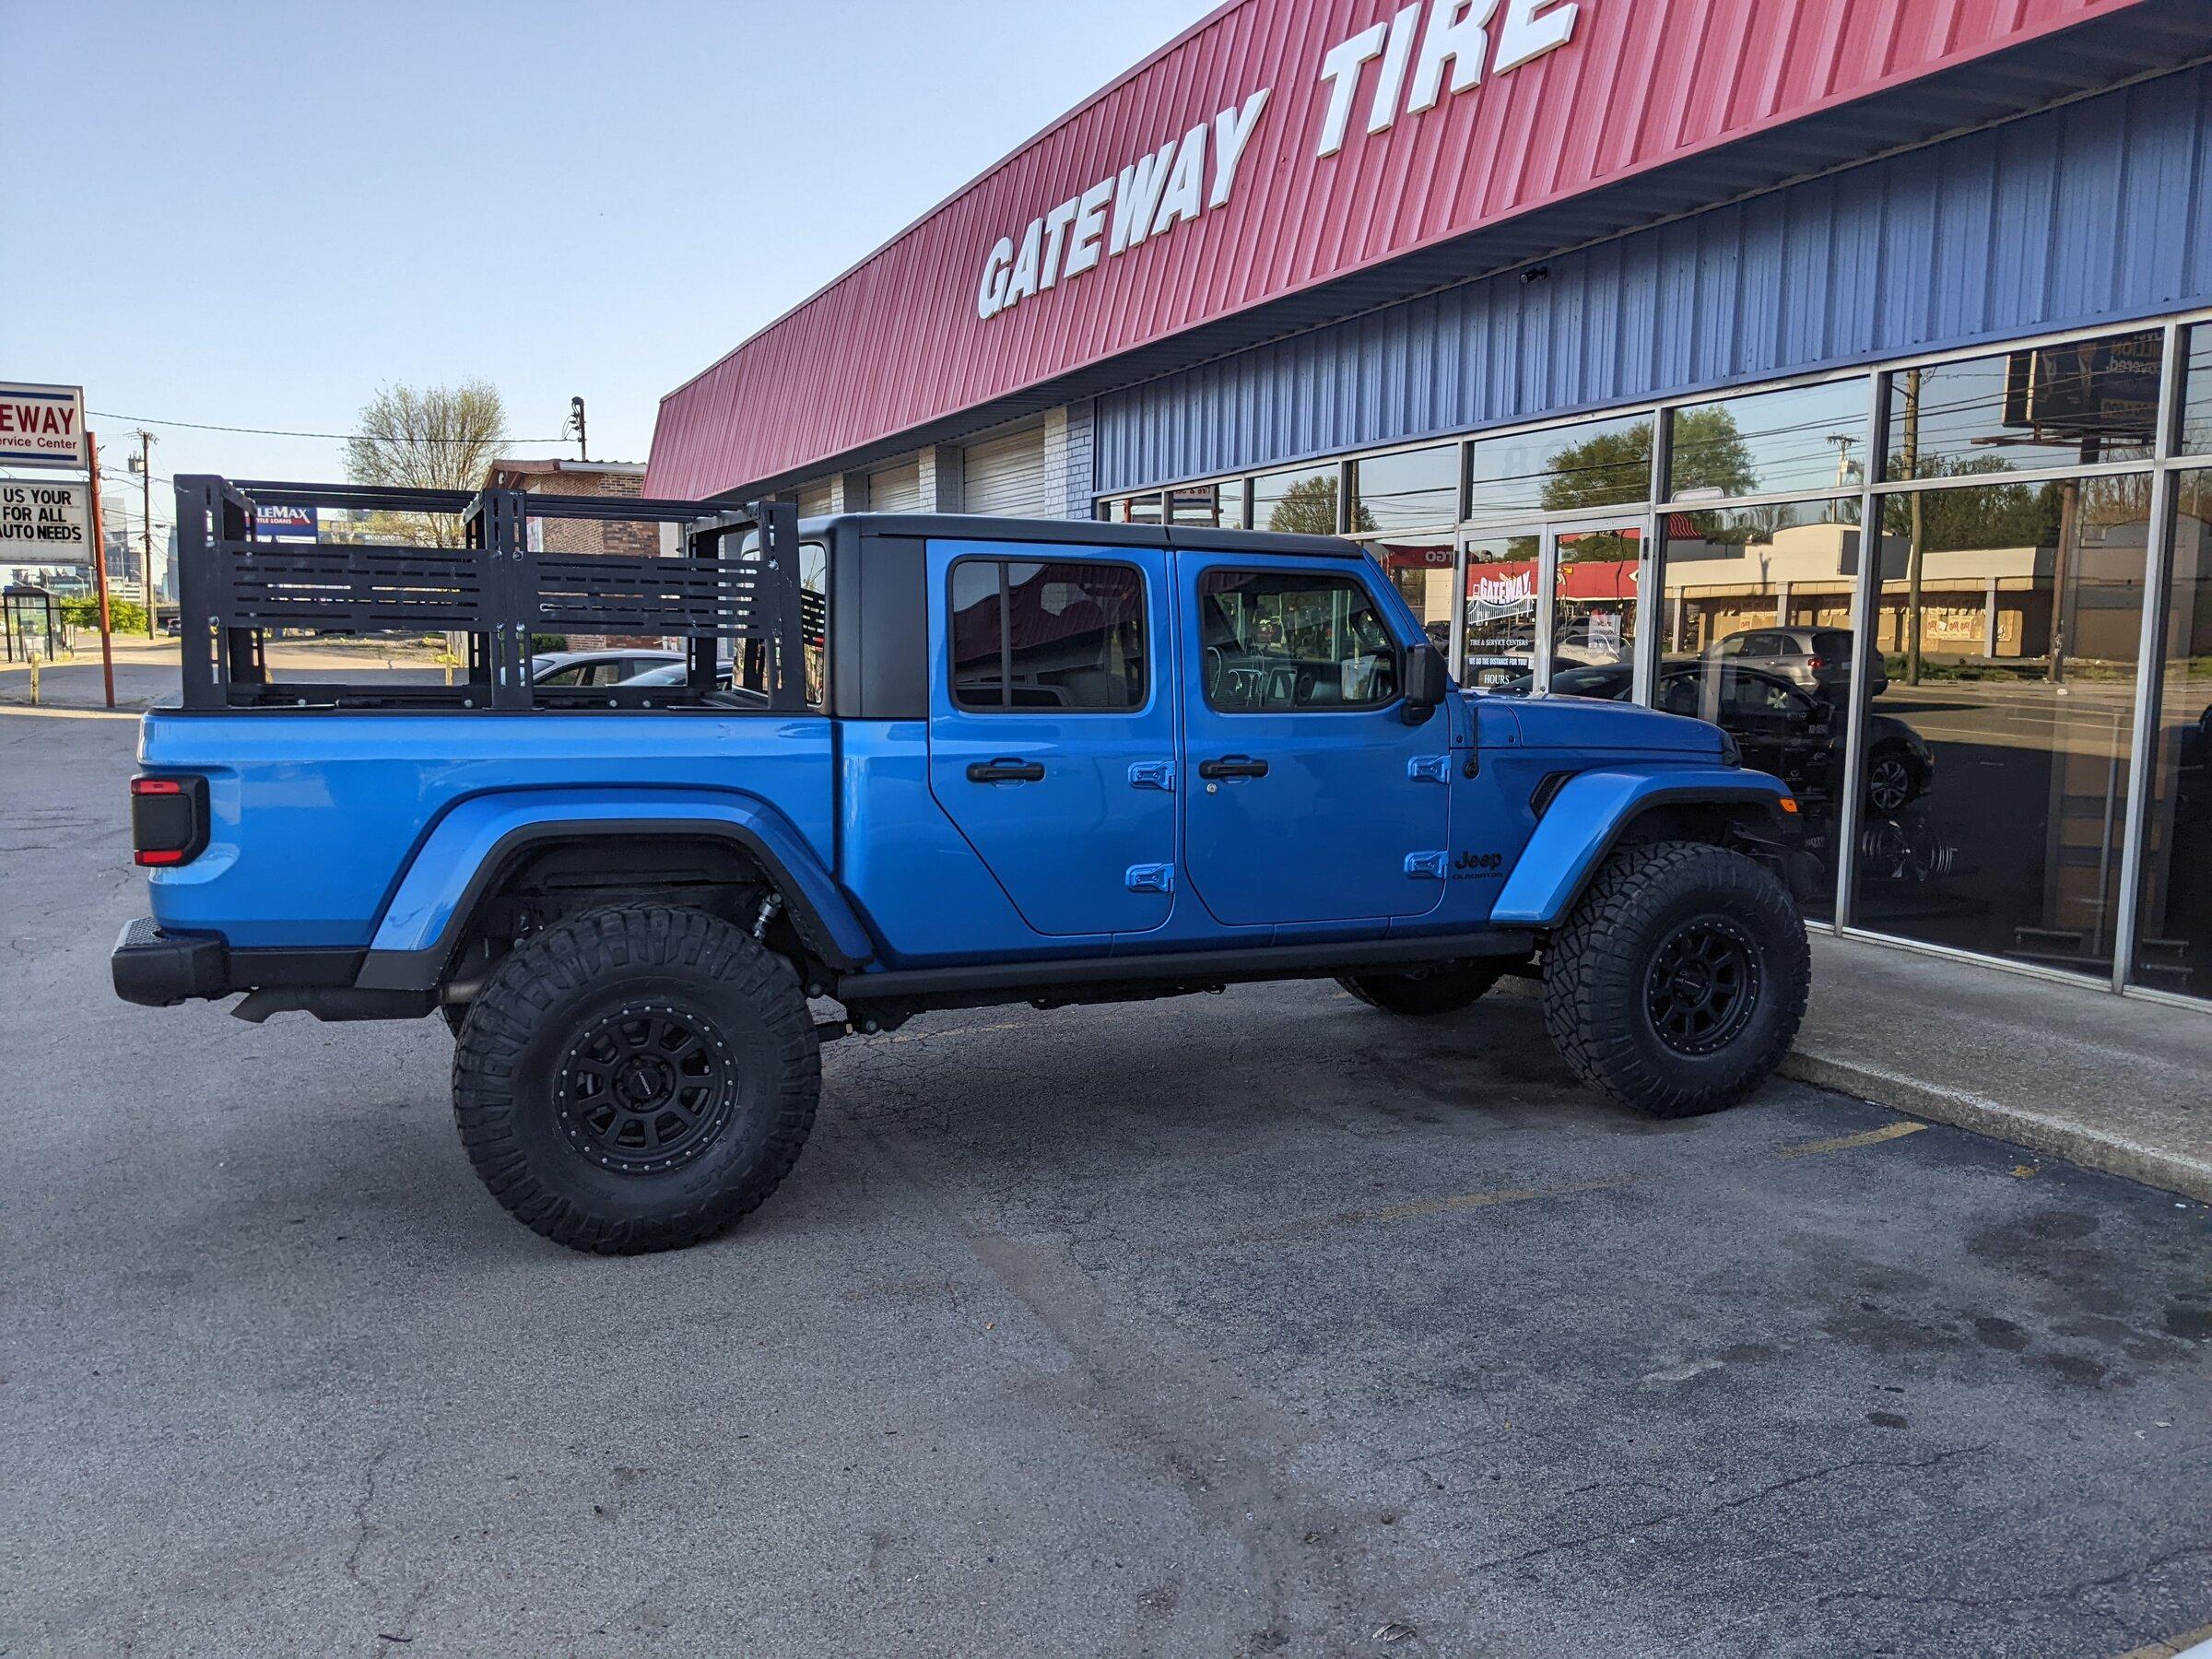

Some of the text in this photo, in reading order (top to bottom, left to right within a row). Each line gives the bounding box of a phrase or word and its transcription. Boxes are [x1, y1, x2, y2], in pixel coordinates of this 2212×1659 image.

[978, 0, 1579, 320] GATEWAY TIRE
[37, 437, 76, 449] Center
[4, 488, 71, 505] US YOUR
[4, 507, 66, 523] FOR ALL
[37, 525, 82, 541] NEEDS
[1480, 571, 1530, 605] GATEWAY
[1484, 674, 1510, 684] HOURS
[1454, 851, 1502, 871] Jeep
